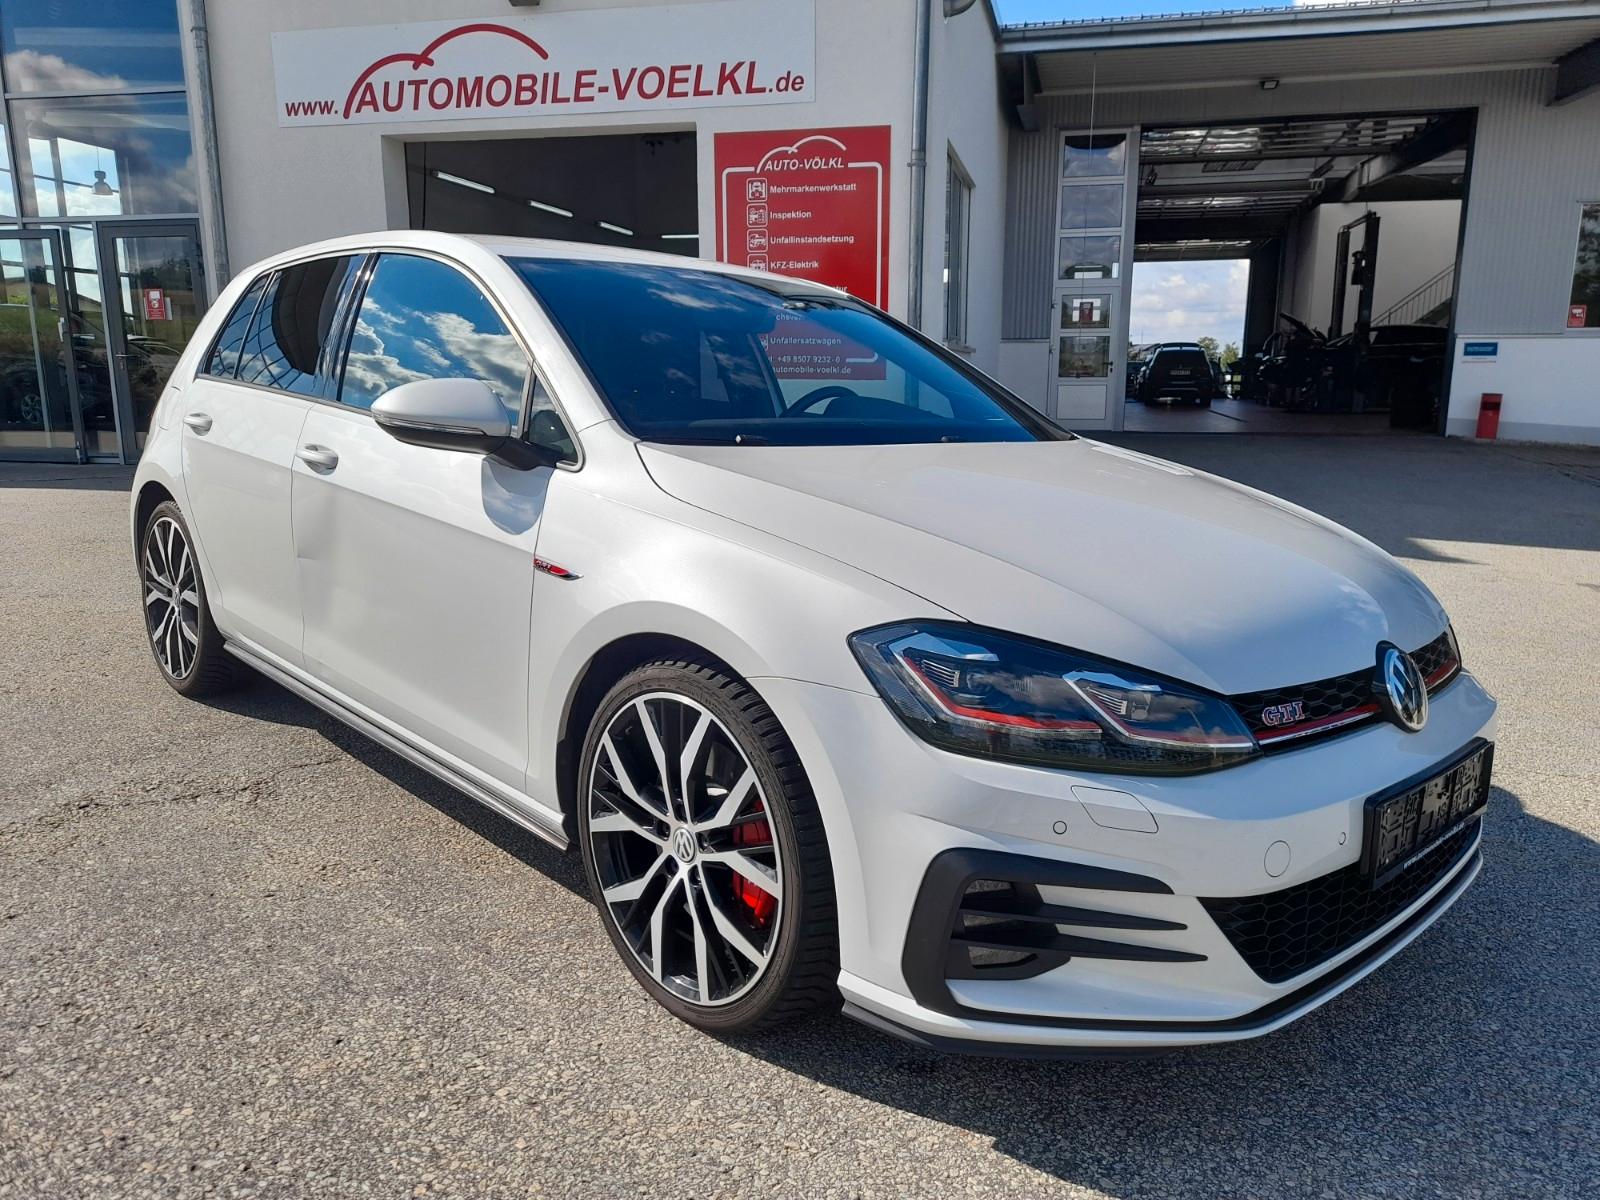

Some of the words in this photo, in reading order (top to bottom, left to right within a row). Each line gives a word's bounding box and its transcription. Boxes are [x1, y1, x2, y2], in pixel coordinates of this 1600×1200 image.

[764, 156, 845, 171] AUTO-VÖLKL
[769, 183, 857, 193] Mehrmarkenwerkstatt
[770, 210, 812, 220] Inspektion
[770, 234, 855, 244] Unfallinstandsetzung
[770, 261, 819, 270] KFZ-Elektrik
[770, 336, 841, 346] Unfallersatzwagen
[1262, 701, 1305, 726] GTI
